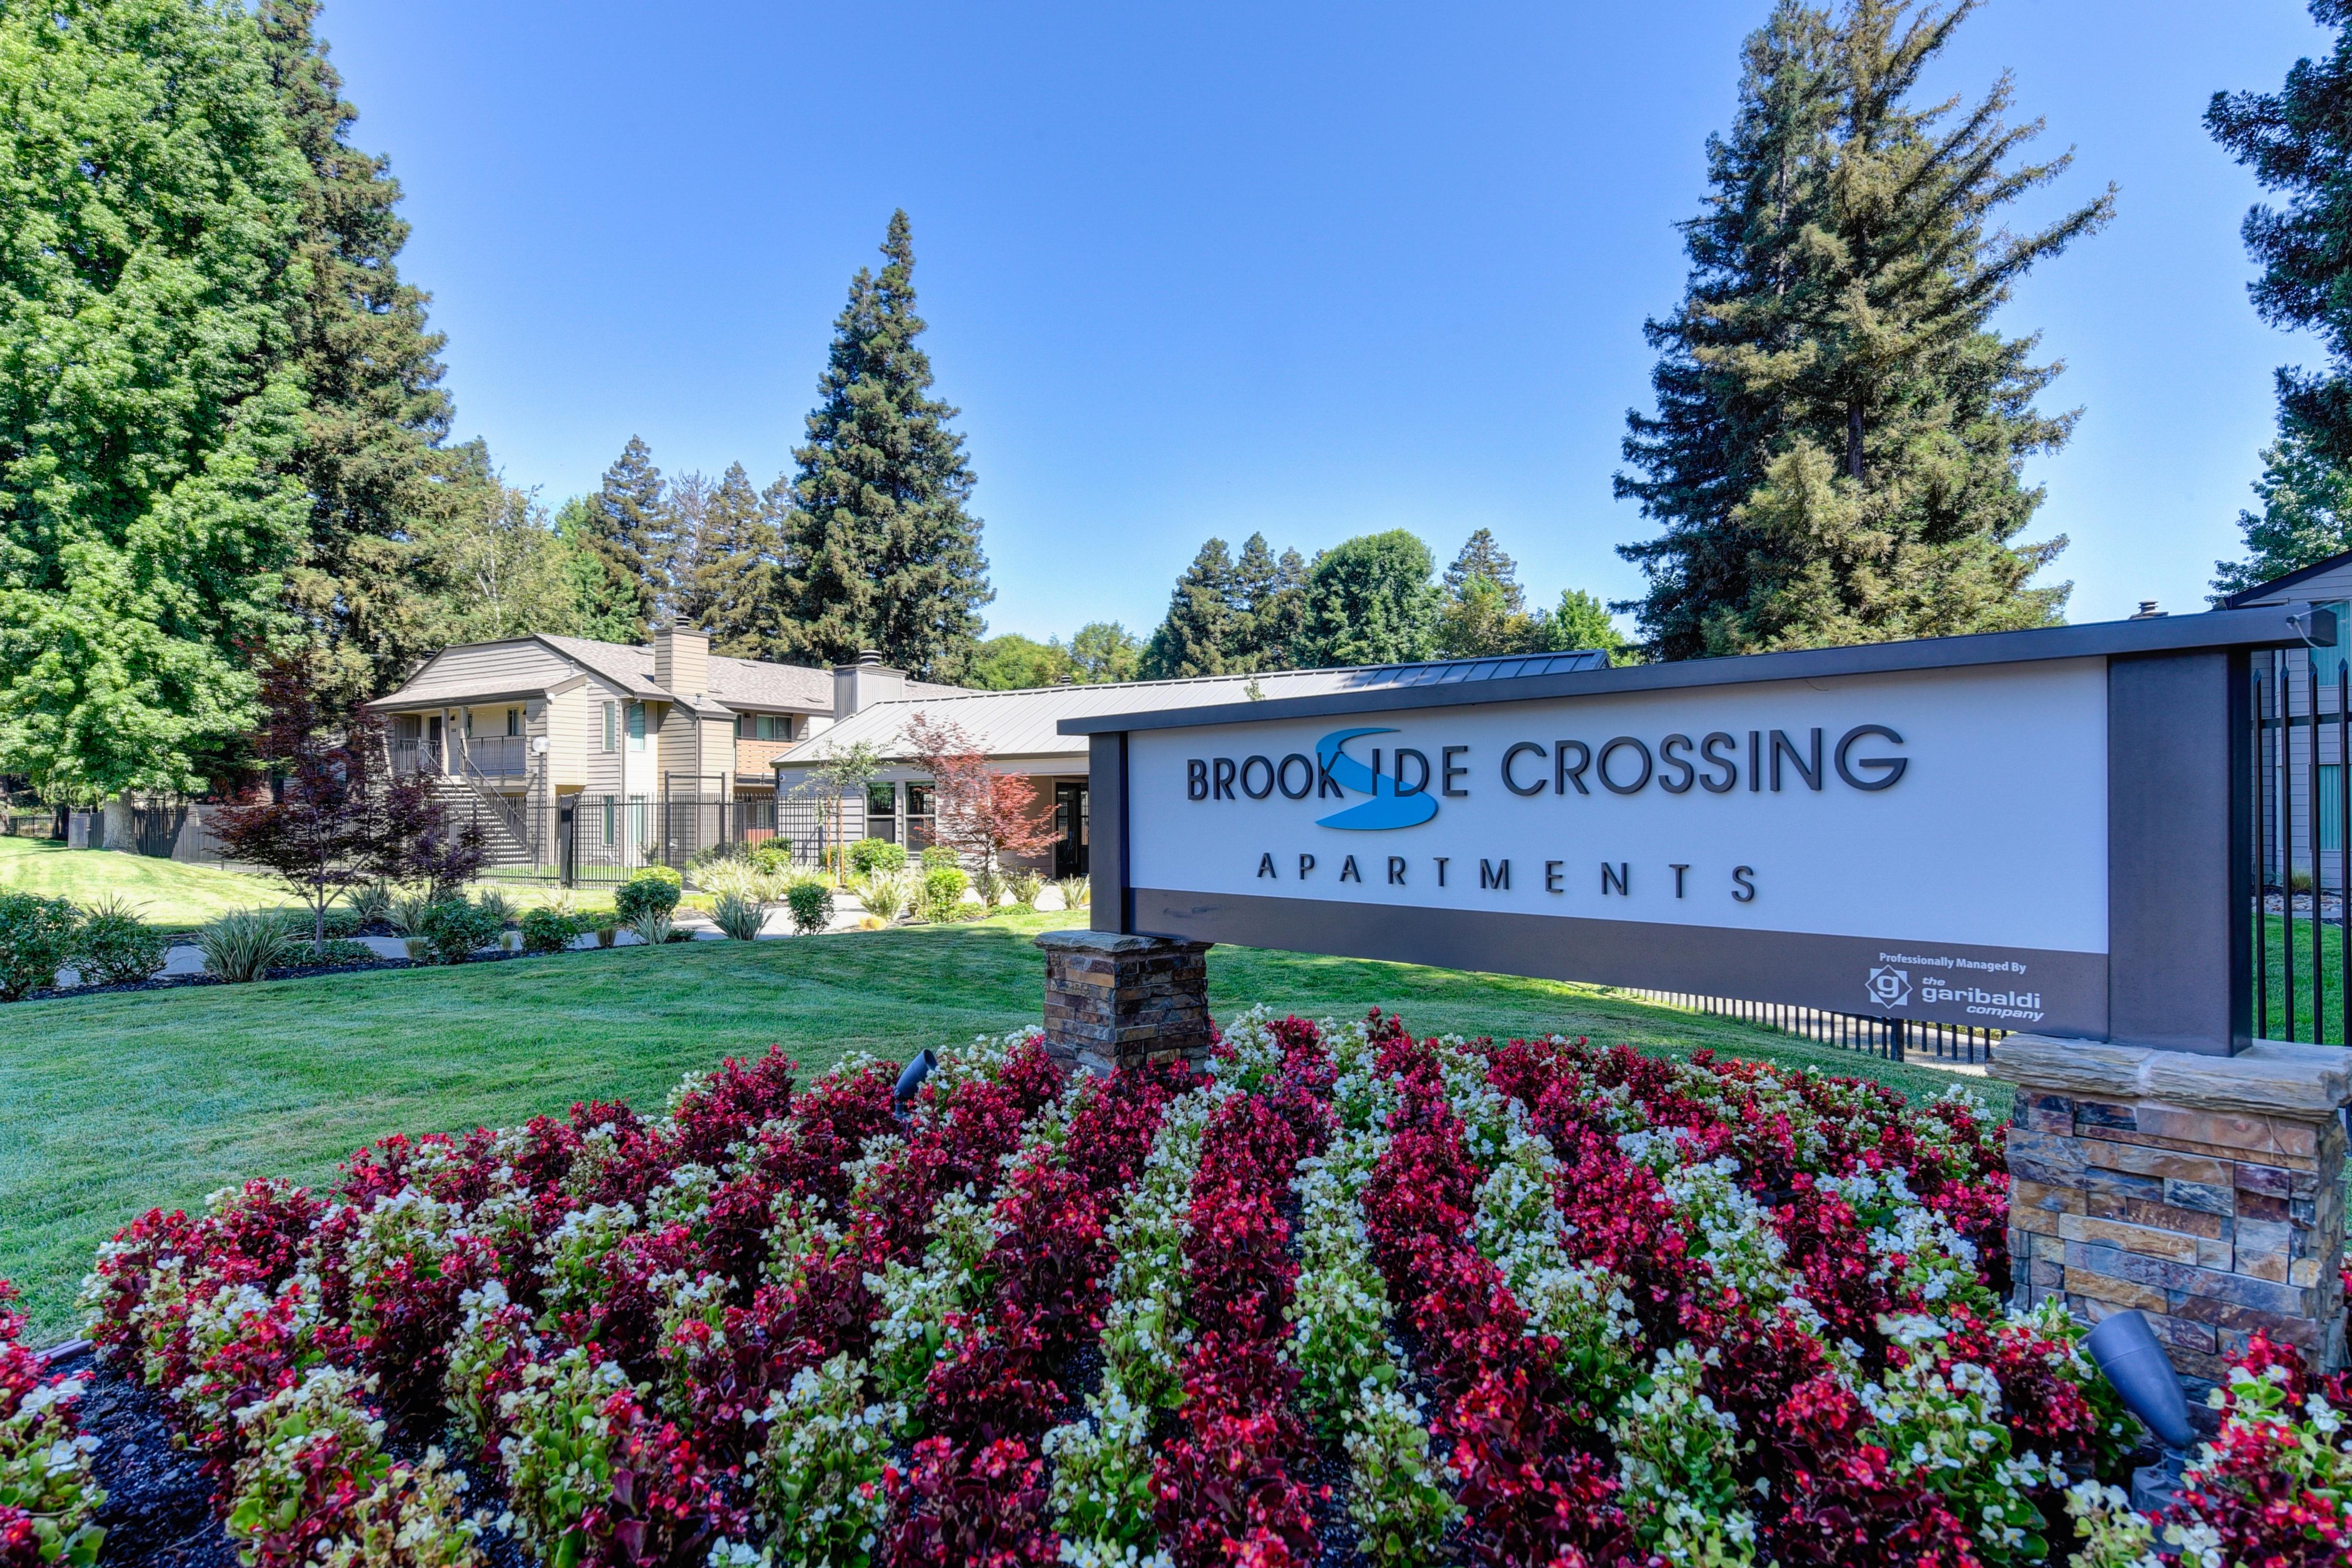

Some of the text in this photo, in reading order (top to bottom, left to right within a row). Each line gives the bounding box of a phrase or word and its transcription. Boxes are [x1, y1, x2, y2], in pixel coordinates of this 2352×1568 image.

[1501, 724, 1908, 796] CROSSING
[1256, 852, 1755, 902] APARTMENTS
[1879, 952, 2027, 975] Professionally Managed By
[1877, 975, 1899, 998] g
[1922, 976, 1945, 986] the
[1921, 987, 2041, 1009] garibaldi
[1966, 1005, 2044, 1022] company
